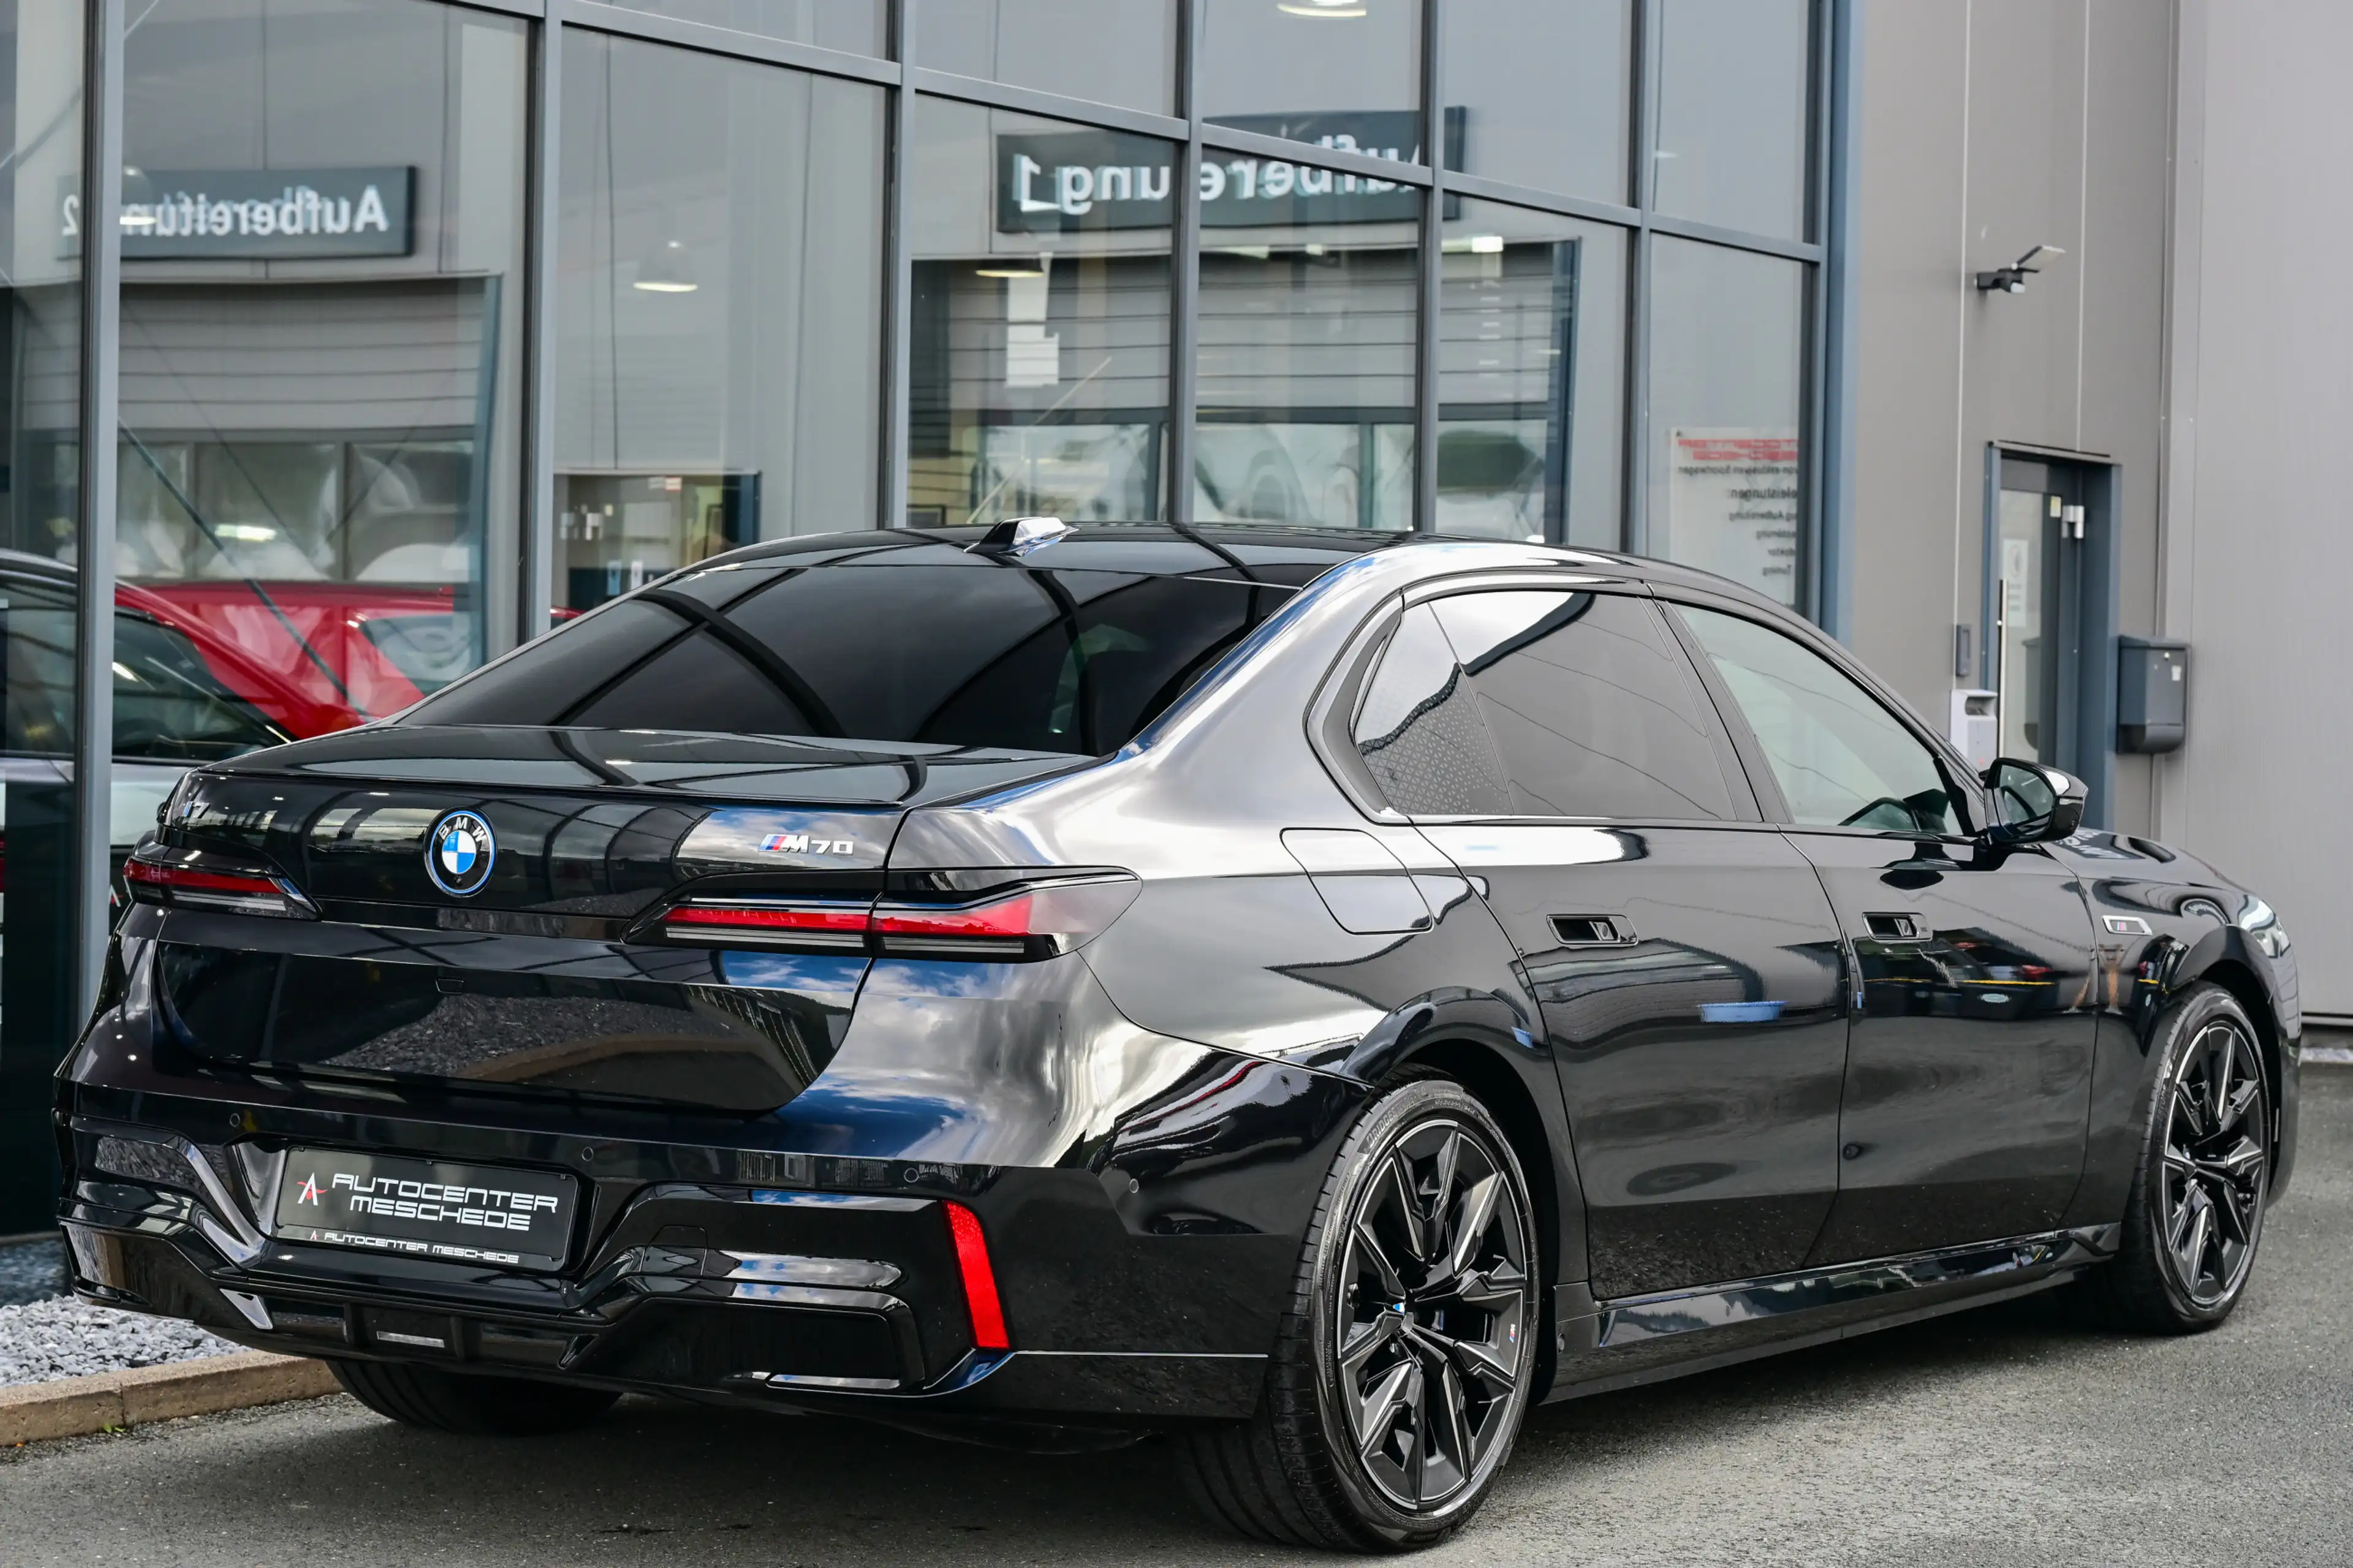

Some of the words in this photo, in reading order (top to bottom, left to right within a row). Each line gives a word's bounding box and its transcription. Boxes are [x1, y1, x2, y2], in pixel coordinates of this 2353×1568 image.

[438, 816, 487, 843] BMW
[759, 833, 854, 855] M70
[332, 1173, 559, 1213] AUTOCENTER
[349, 1195, 531, 1232] MESCHEDE
[324, 1232, 428, 1252] AUTOCENTER
[431, 1244, 520, 1264] MESCHEDE
